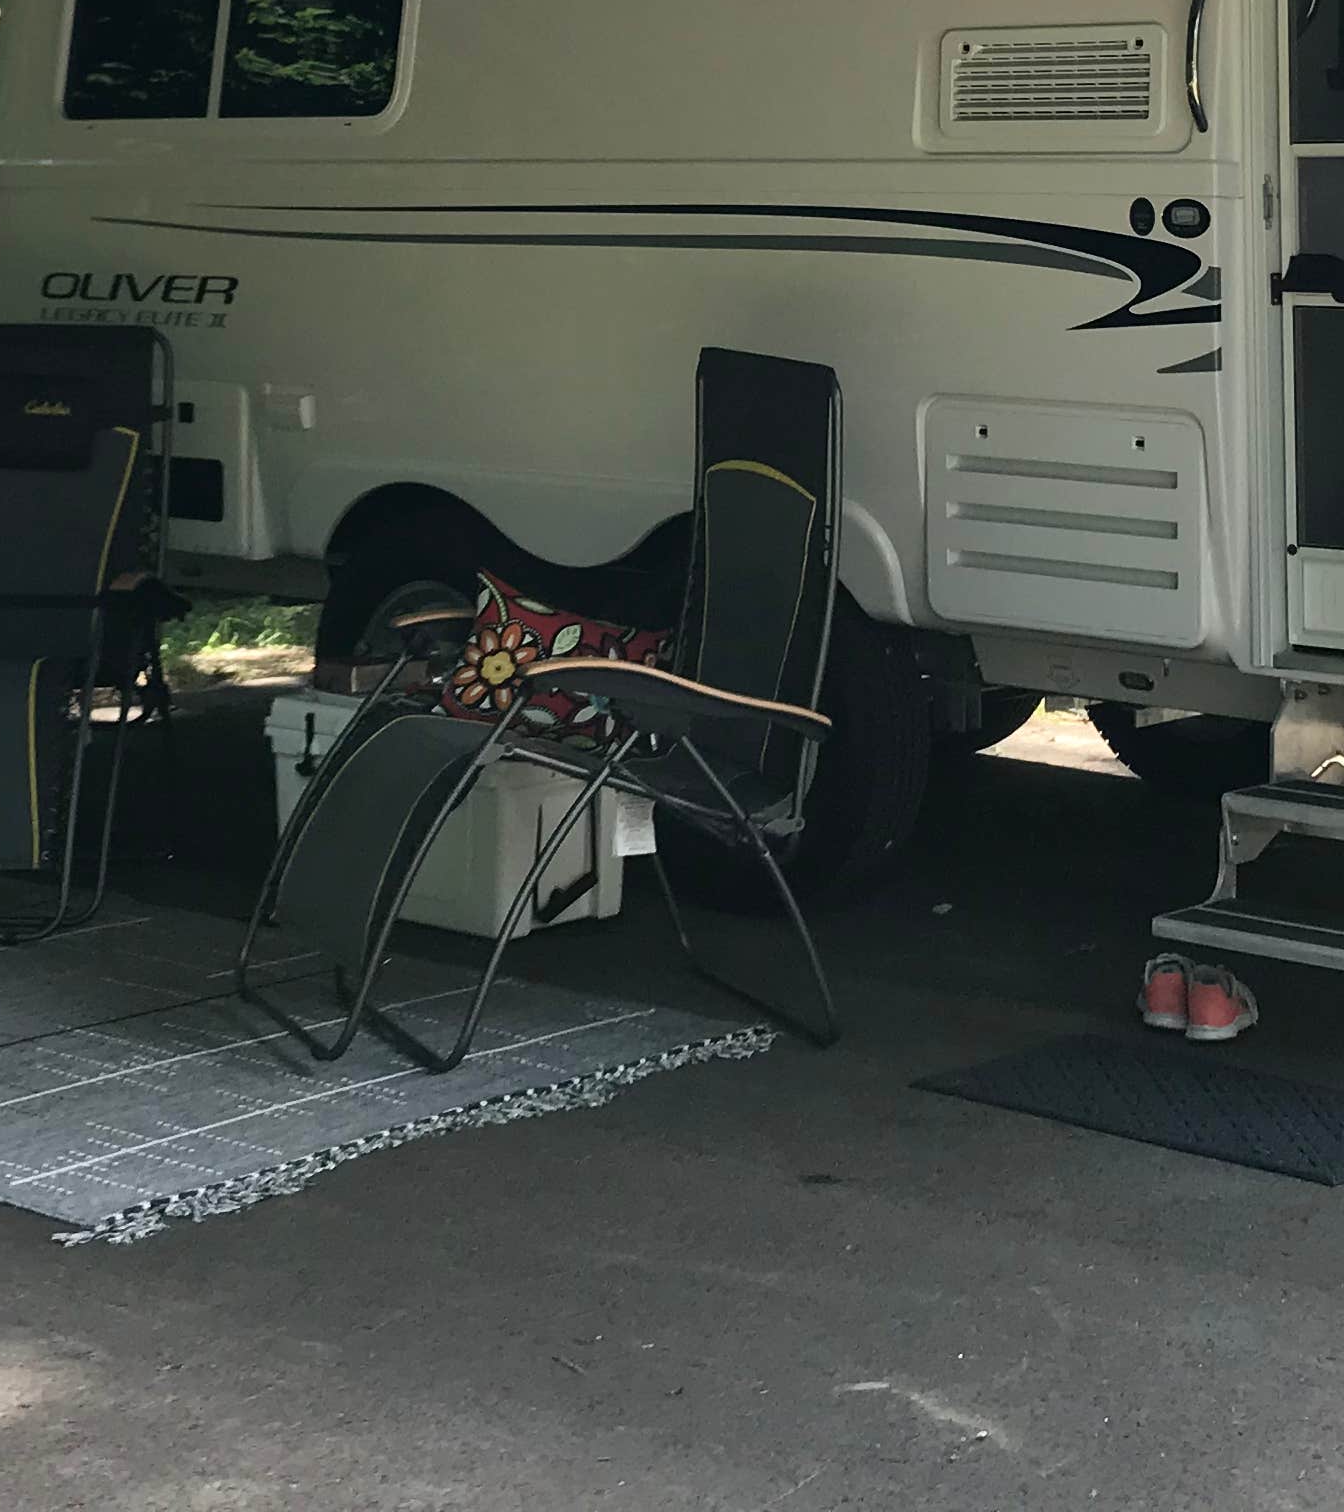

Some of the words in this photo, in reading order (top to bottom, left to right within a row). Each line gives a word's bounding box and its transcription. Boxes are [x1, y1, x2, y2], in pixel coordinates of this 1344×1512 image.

[41, 272, 239, 304] OLIVER
[40, 306, 128, 324] LEGACY
[136, 309, 199, 327] ELITE
